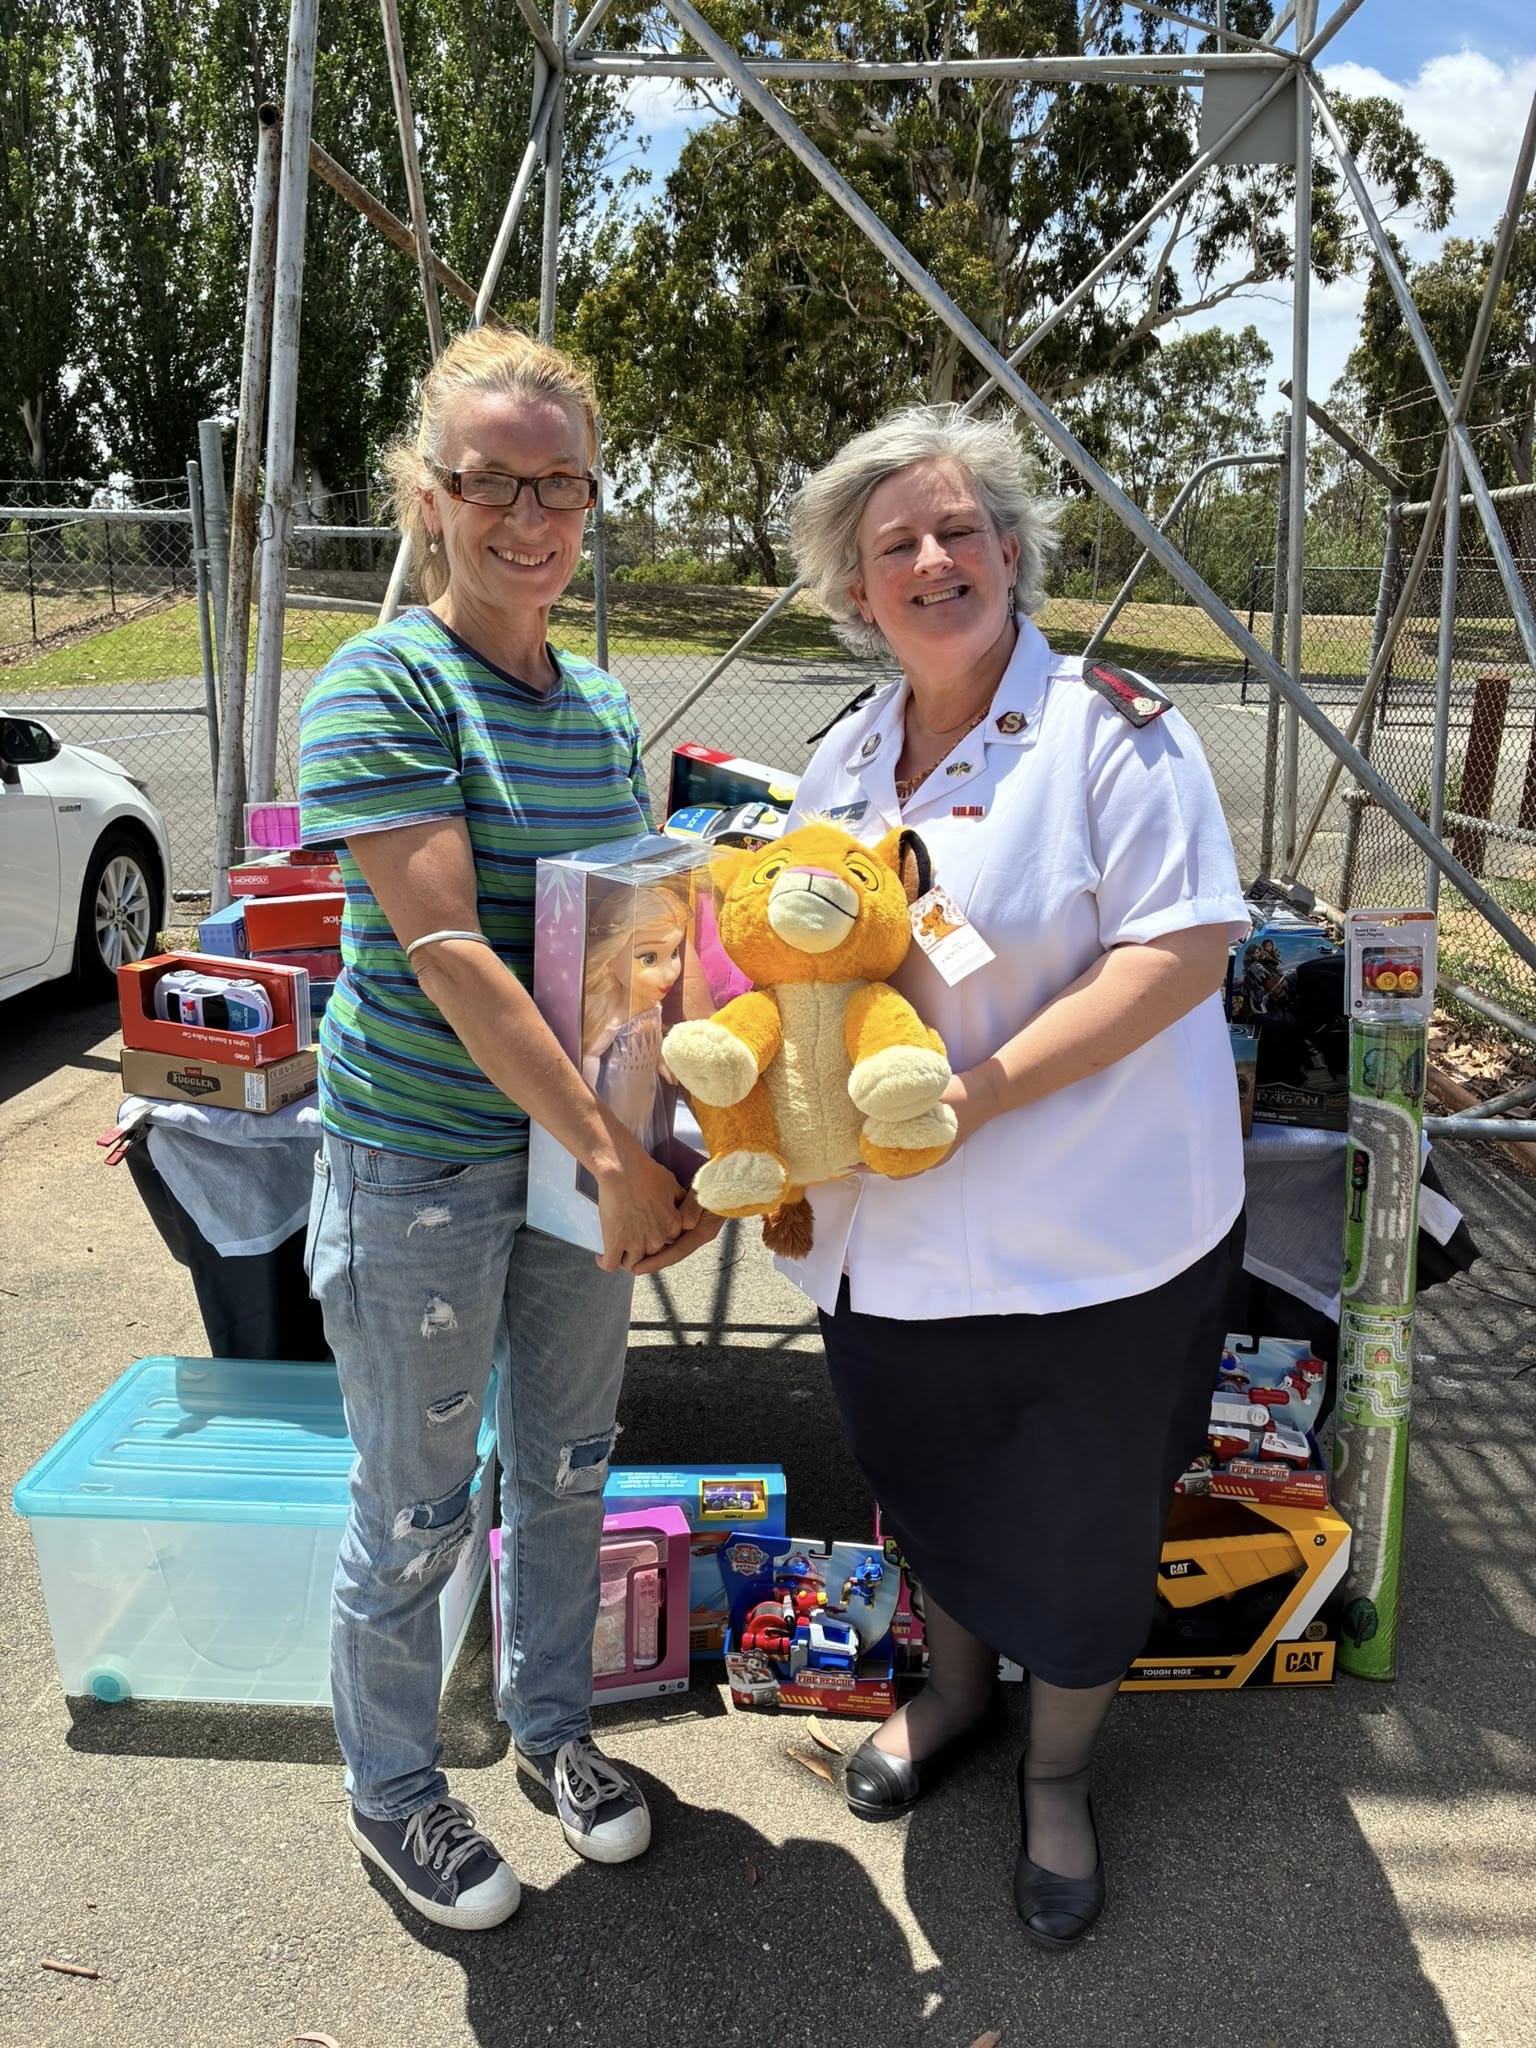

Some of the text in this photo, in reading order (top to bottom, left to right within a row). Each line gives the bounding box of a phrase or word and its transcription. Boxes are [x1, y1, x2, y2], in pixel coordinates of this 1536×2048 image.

[1001, 713, 1022, 732] S
[234, 876, 268, 884] MONOPOLY
[322, 915, 342, 925] rice
[172, 1071, 217, 1090] FUGGLER
[1231, 1464, 1288, 1479] FIRE RESCUE
[726, 1546, 769, 1565] PAW
[1170, 1562, 1189, 1575] CAT
[1285, 1651, 1324, 1673] CAT
[798, 1674, 854, 1687] FIRE RESCUE
